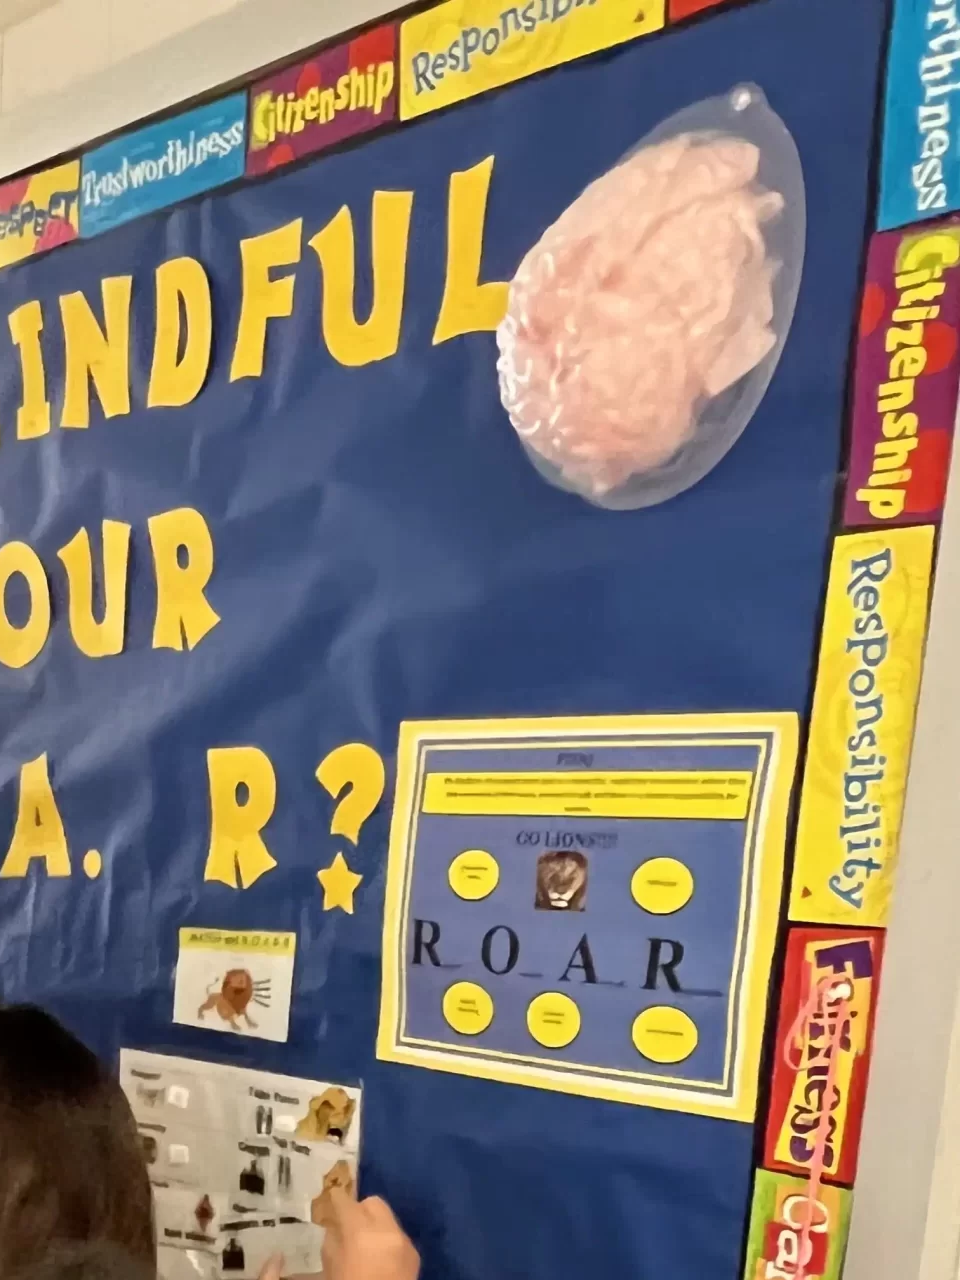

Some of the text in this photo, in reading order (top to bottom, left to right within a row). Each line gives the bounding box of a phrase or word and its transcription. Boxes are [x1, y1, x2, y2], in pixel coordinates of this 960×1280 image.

[81, 119, 245, 207] Trustworthiness
[251, 61, 394, 149] Citizenship
[855, 236, 960, 520] Citizenship
[828, 547, 894, 910] Responsibility
